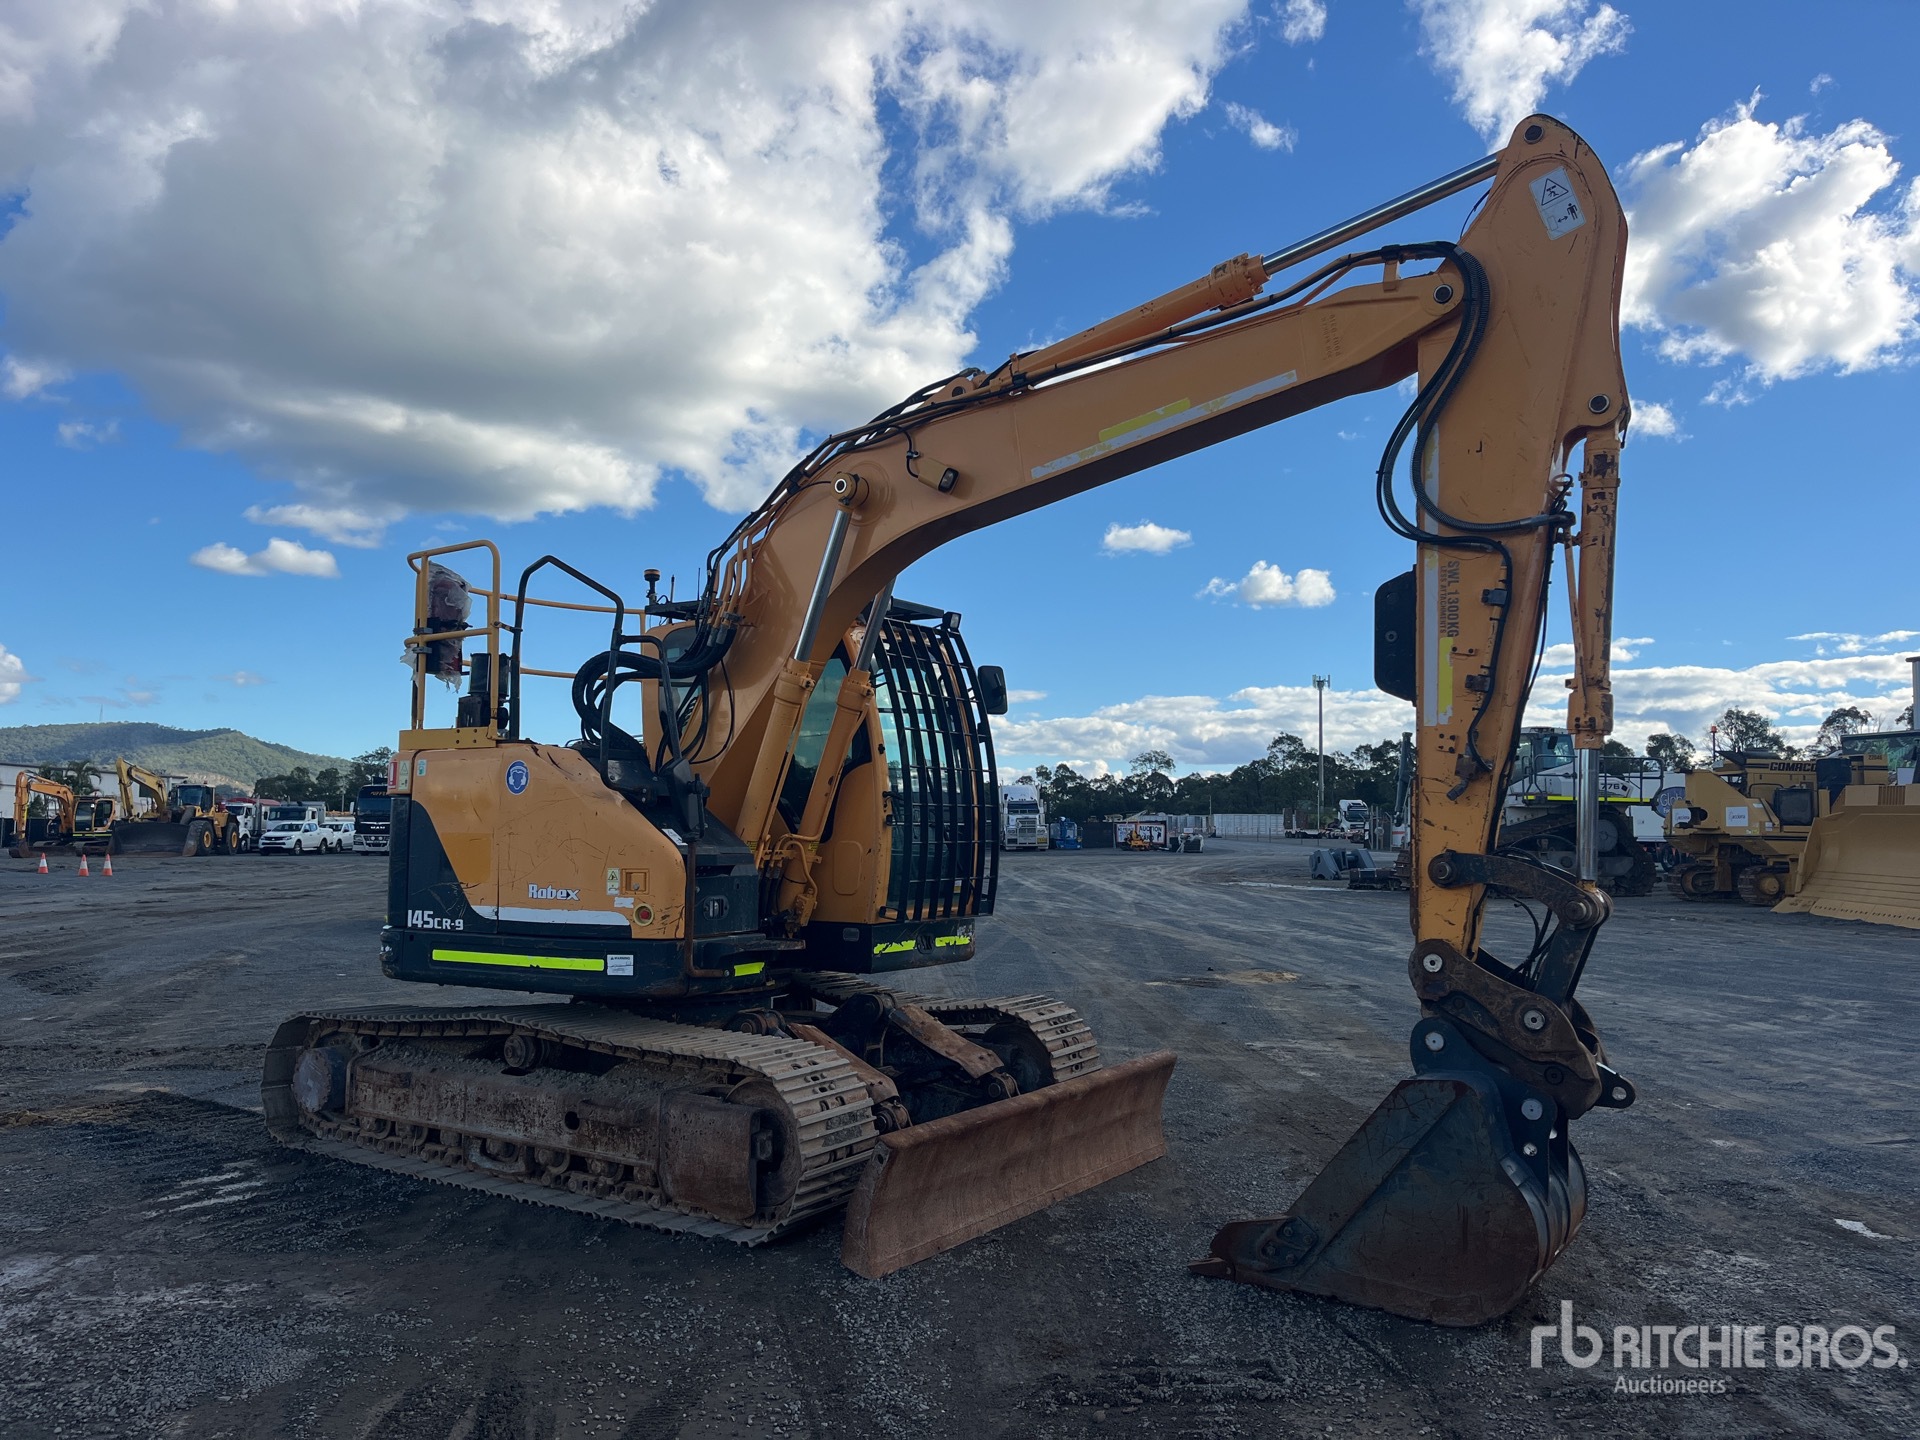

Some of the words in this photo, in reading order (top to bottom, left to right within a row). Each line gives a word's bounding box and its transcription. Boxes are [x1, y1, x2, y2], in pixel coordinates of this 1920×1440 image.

[1448, 561, 1460, 587] SWL
[1447, 590, 1460, 637] 1300KG
[528, 883, 580, 901] Robex
